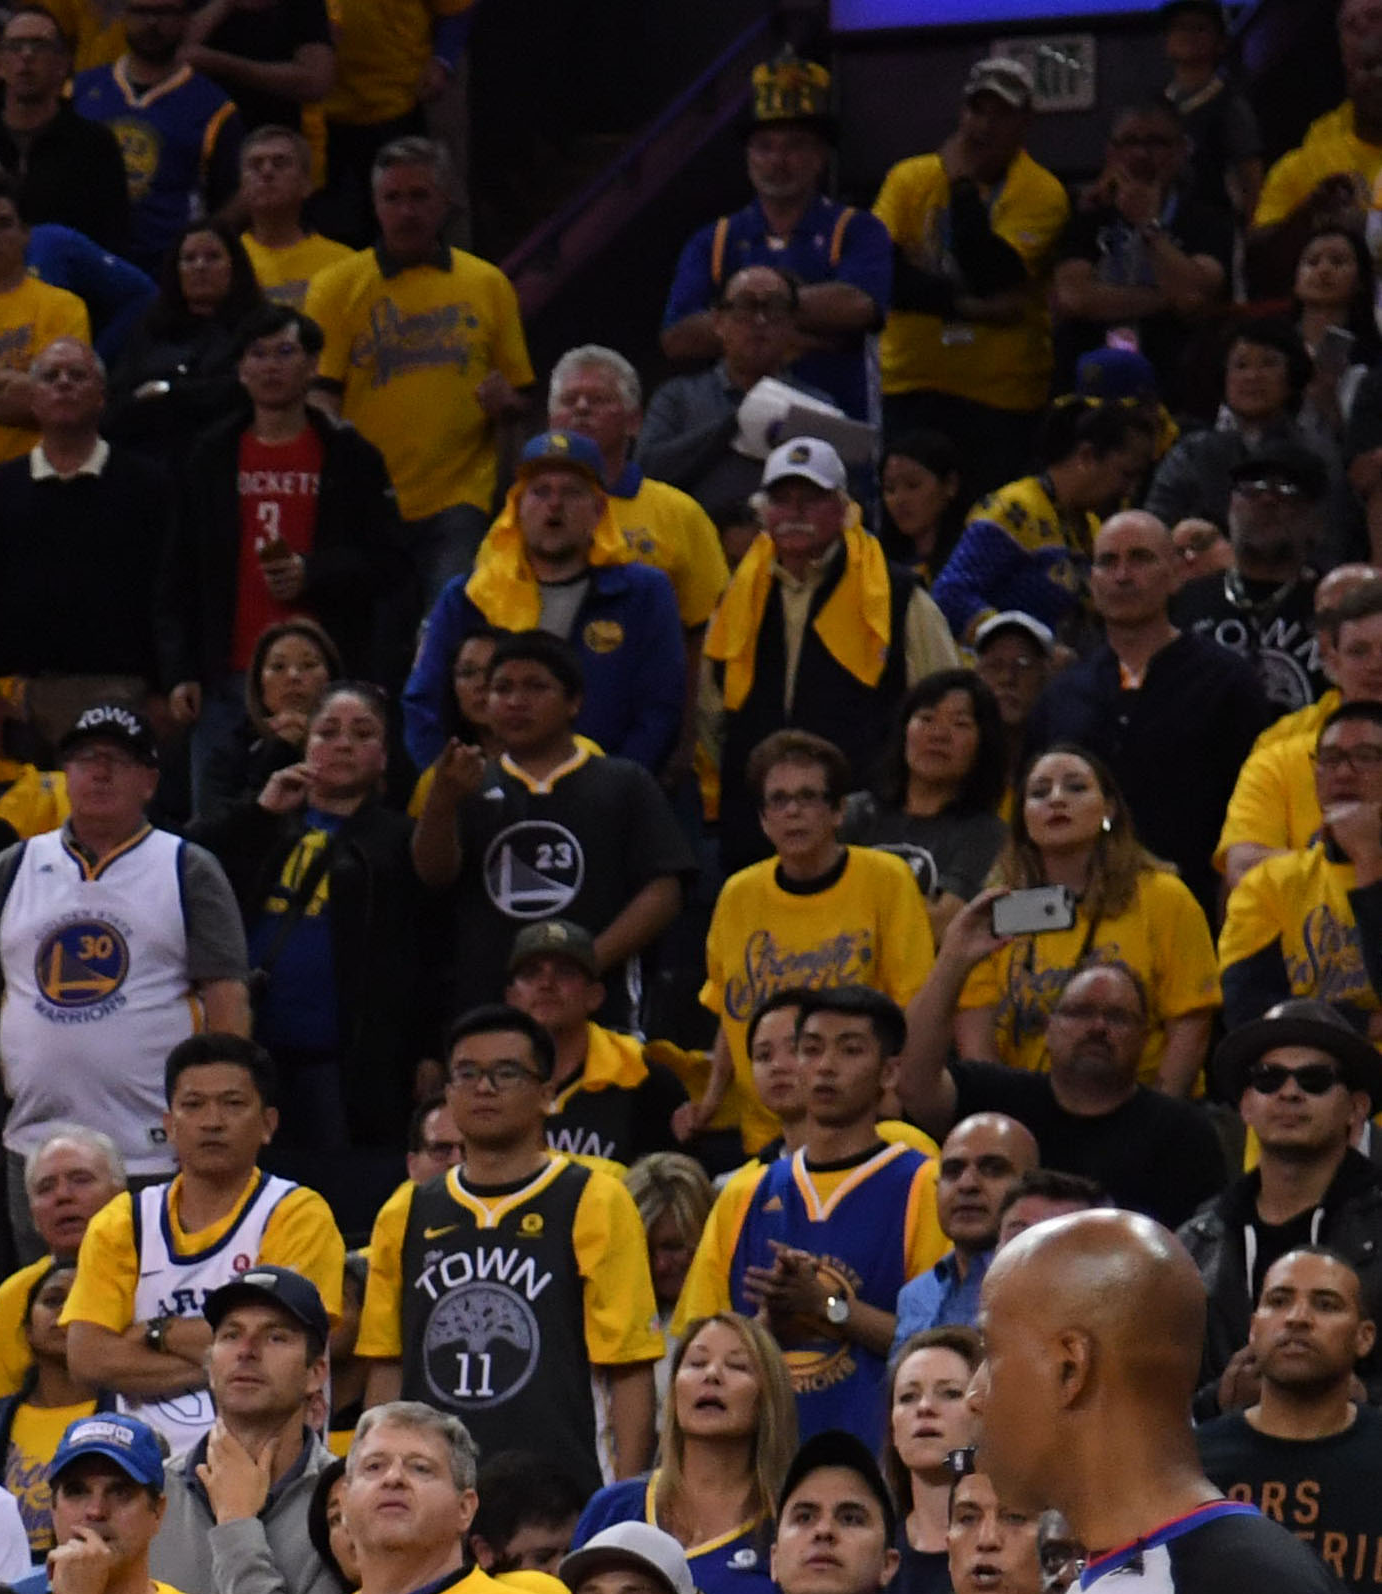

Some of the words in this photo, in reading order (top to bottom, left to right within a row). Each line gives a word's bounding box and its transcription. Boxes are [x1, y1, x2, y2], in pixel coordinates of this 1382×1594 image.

[535, 842, 575, 870] 23
[77, 935, 114, 961] 30
[545, 1127, 616, 1159] WN
[413, 1245, 553, 1301] TOWN
[453, 1351, 495, 1398] 11
